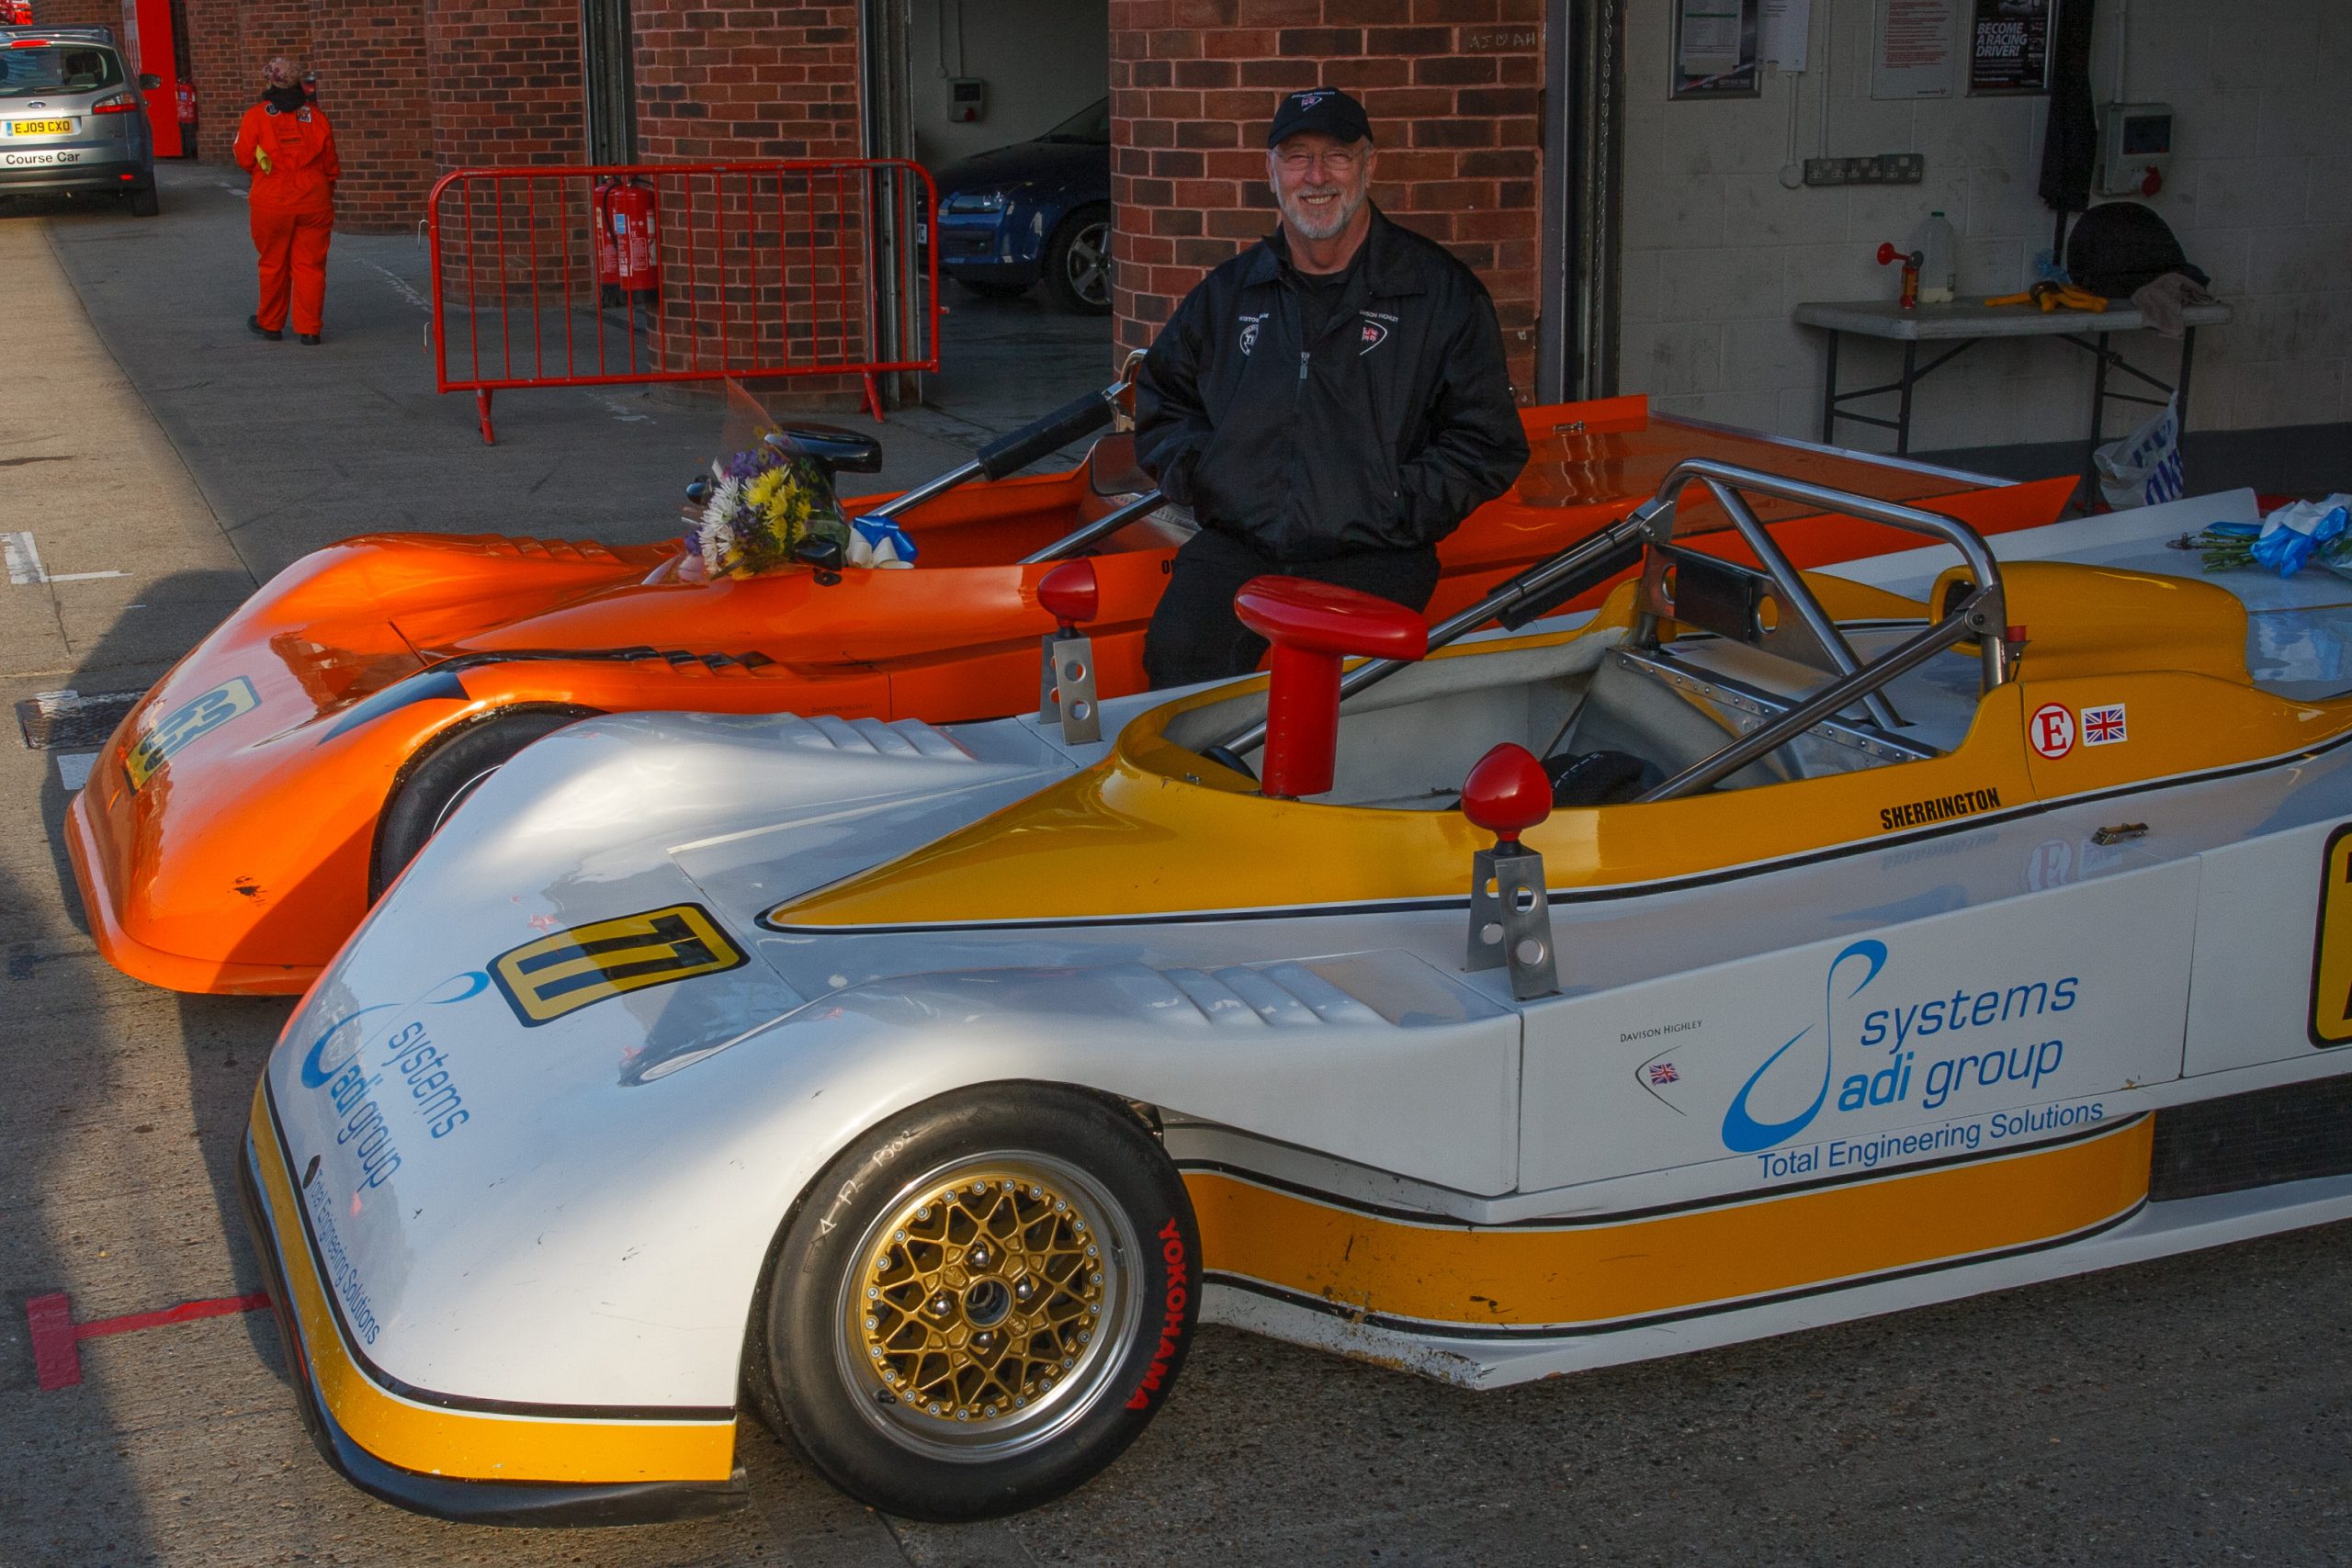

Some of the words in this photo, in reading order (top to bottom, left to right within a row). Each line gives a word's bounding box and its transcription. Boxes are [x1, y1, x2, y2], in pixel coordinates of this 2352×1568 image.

[1976, 46, 2020, 57] DRIVER!
[1977, 22, 2024, 34] BECOME
[1977, 35, 1984, 45] A
[1985, 34, 2028, 45] RACING
[6, 154, 53, 164] Course
[57, 152, 80, 163] Car
[15, 121, 45, 134] EJ09
[48, 120, 71, 132] CXO
[139, 689, 236, 773] 63
[2038, 711, 2068, 753] E
[1880, 787, 2001, 830] SHERRINGTON
[515, 913, 721, 1002] 77
[1620, 1028, 1661, 1043] DAVISON
[1664, 1020, 1703, 1034] HIGHLEY
[1860, 976, 2079, 1055] systems
[330, 1065, 383, 1118] adi
[381, 1021, 470, 1139] systems
[1838, 1051, 1915, 1111] adi
[1922, 1039, 2064, 1110] group
[336, 1100, 402, 1193] group
[1758, 1145, 1818, 1179] Total
[1829, 1121, 1981, 1168] Engineering
[1990, 1102, 2104, 1138] Solutions
[318, 1200, 350, 1288] Engineering
[343, 1269, 380, 1346] Solutions
[1125, 1216, 1188, 1410] YOKOHAMA
